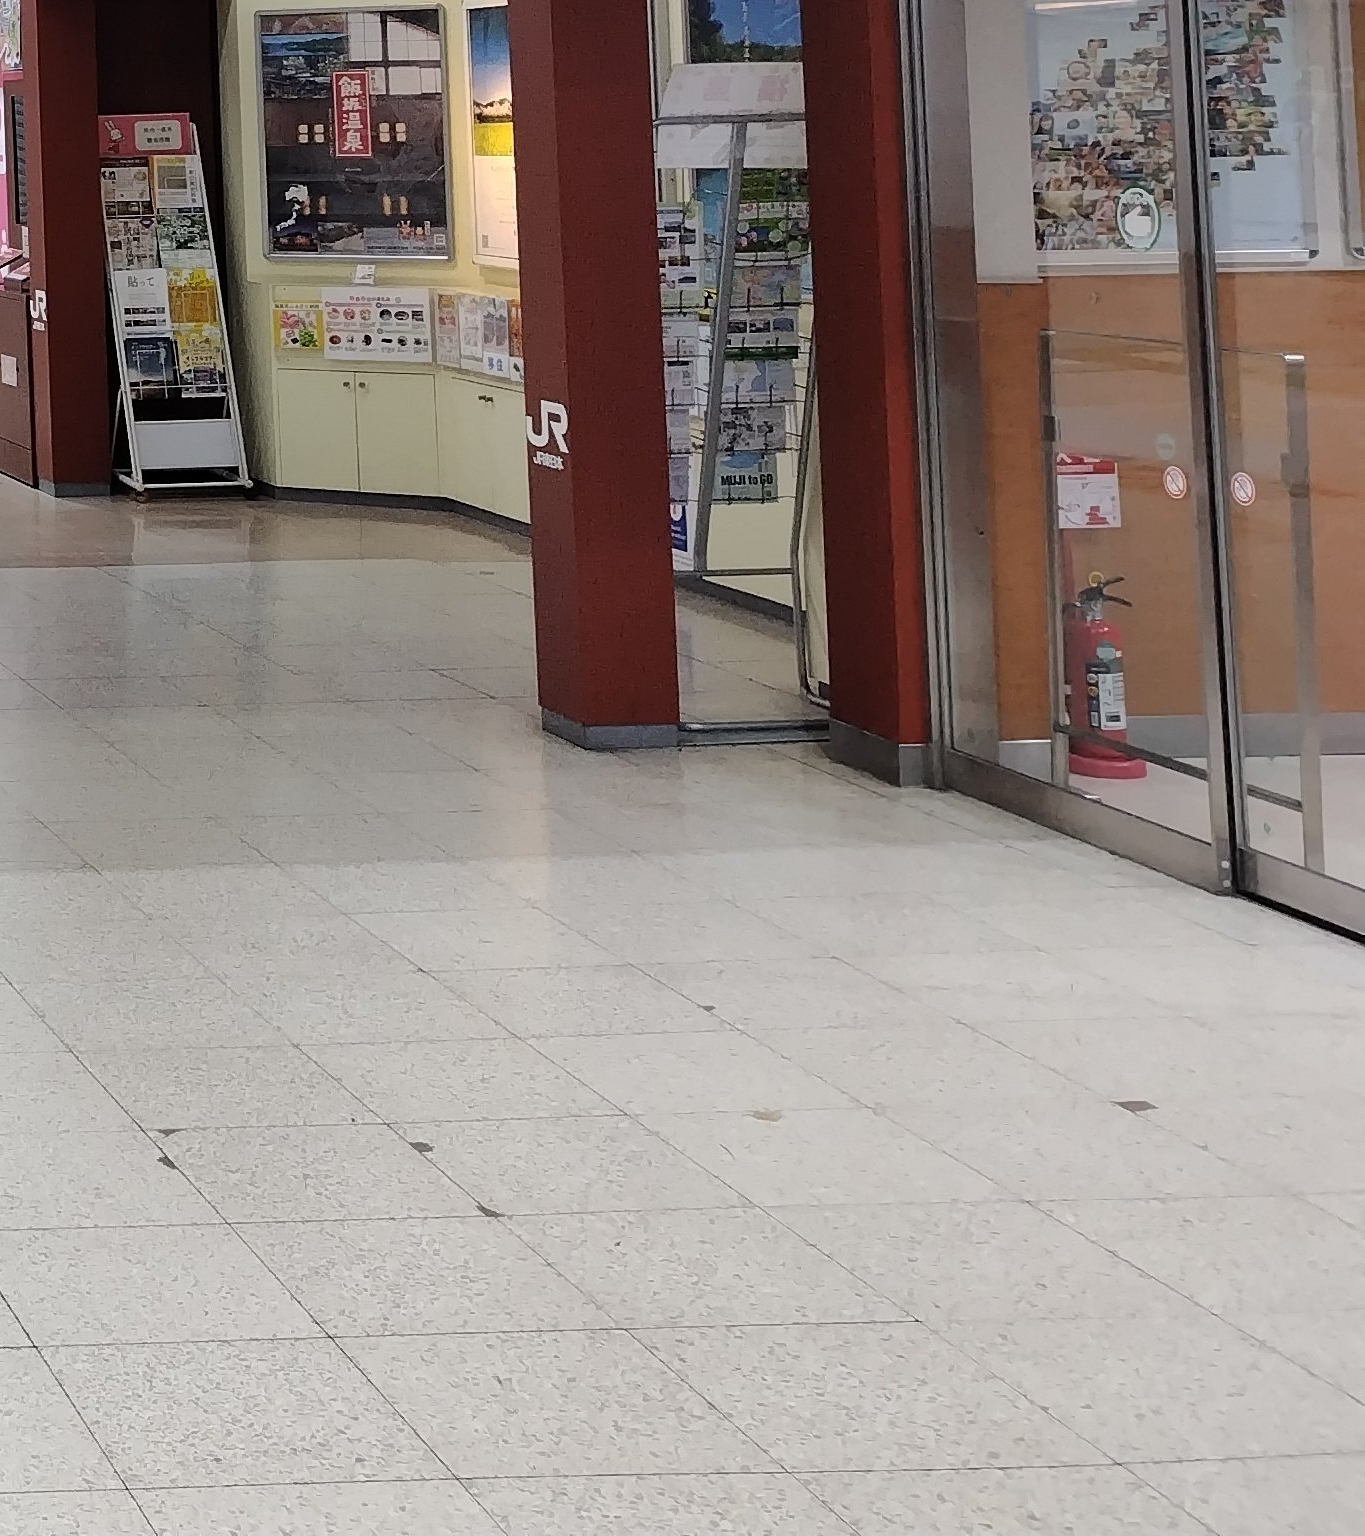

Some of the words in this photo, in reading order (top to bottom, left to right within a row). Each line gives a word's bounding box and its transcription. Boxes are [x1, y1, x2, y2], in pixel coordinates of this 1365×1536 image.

[338, 76, 364, 152] 飯坂温泉
[526, 400, 569, 454] JR
